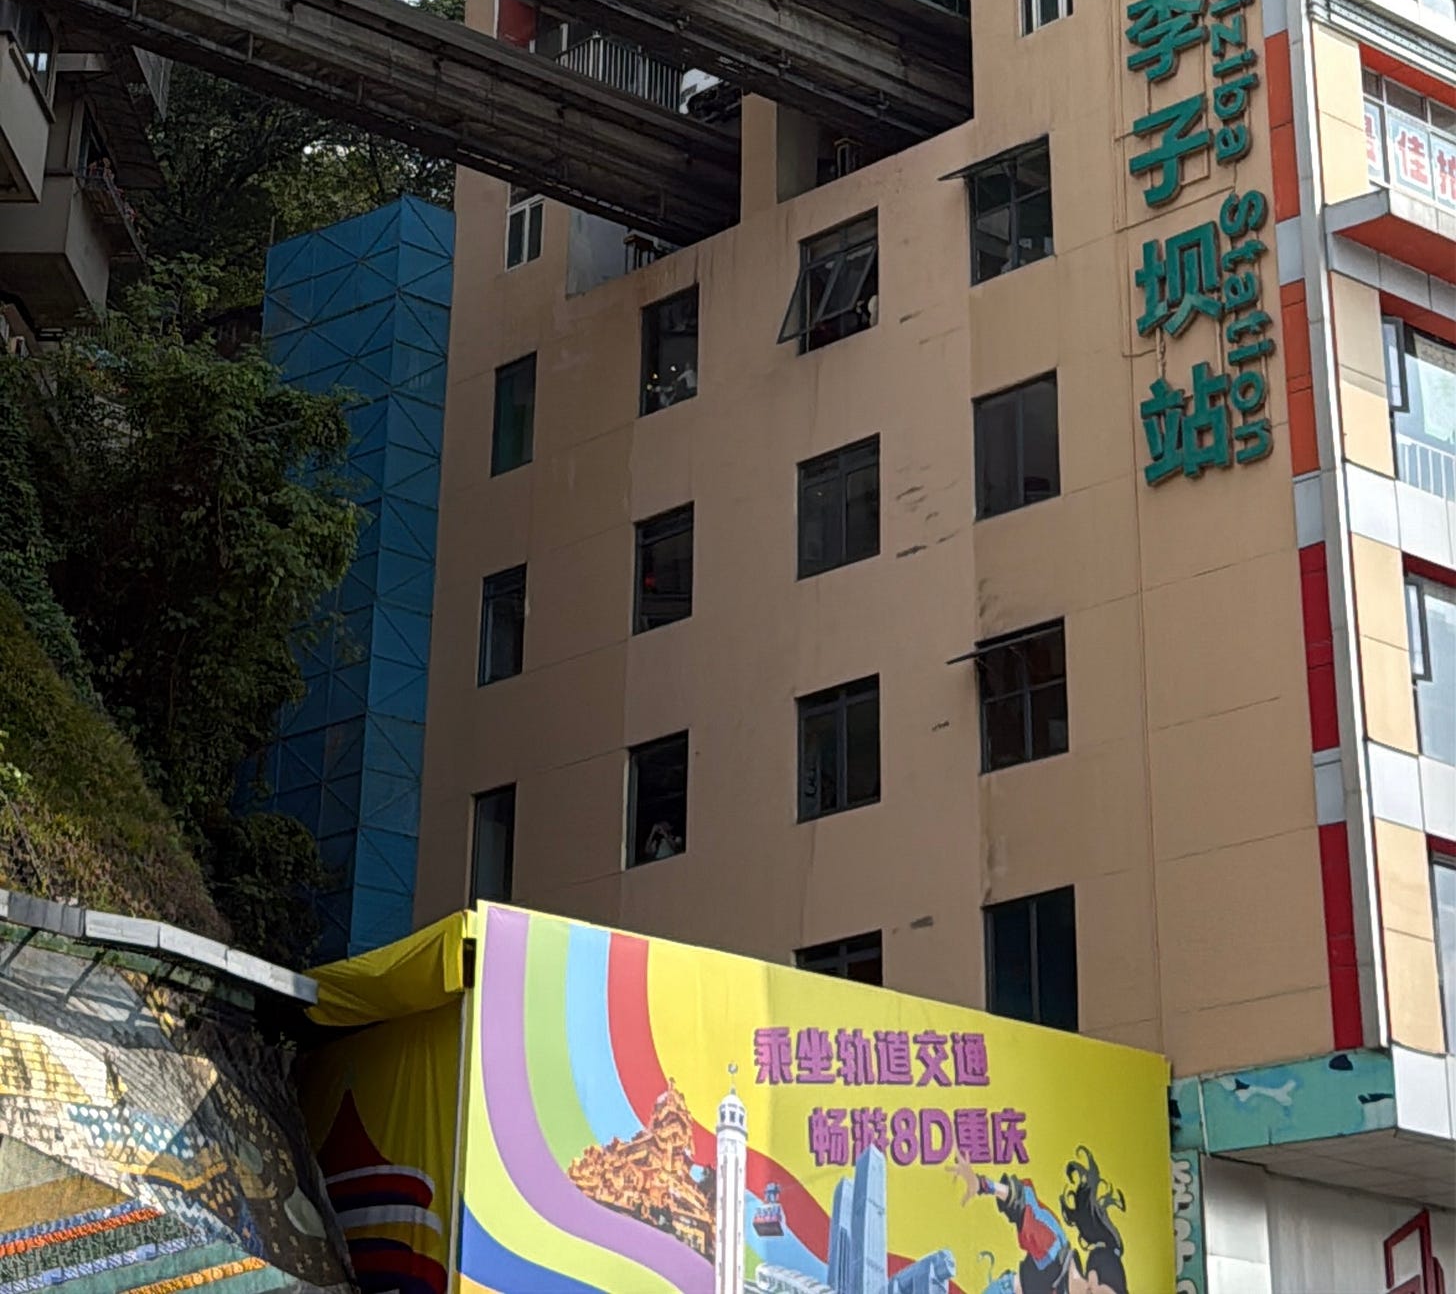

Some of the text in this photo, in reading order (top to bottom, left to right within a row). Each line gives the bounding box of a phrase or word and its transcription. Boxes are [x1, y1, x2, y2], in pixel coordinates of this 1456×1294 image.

[1219, 190, 1277, 466] Station
[754, 1026, 990, 1087] 乘坐轨道交通
[808, 1107, 1030, 1167] 畅游8D重庆
